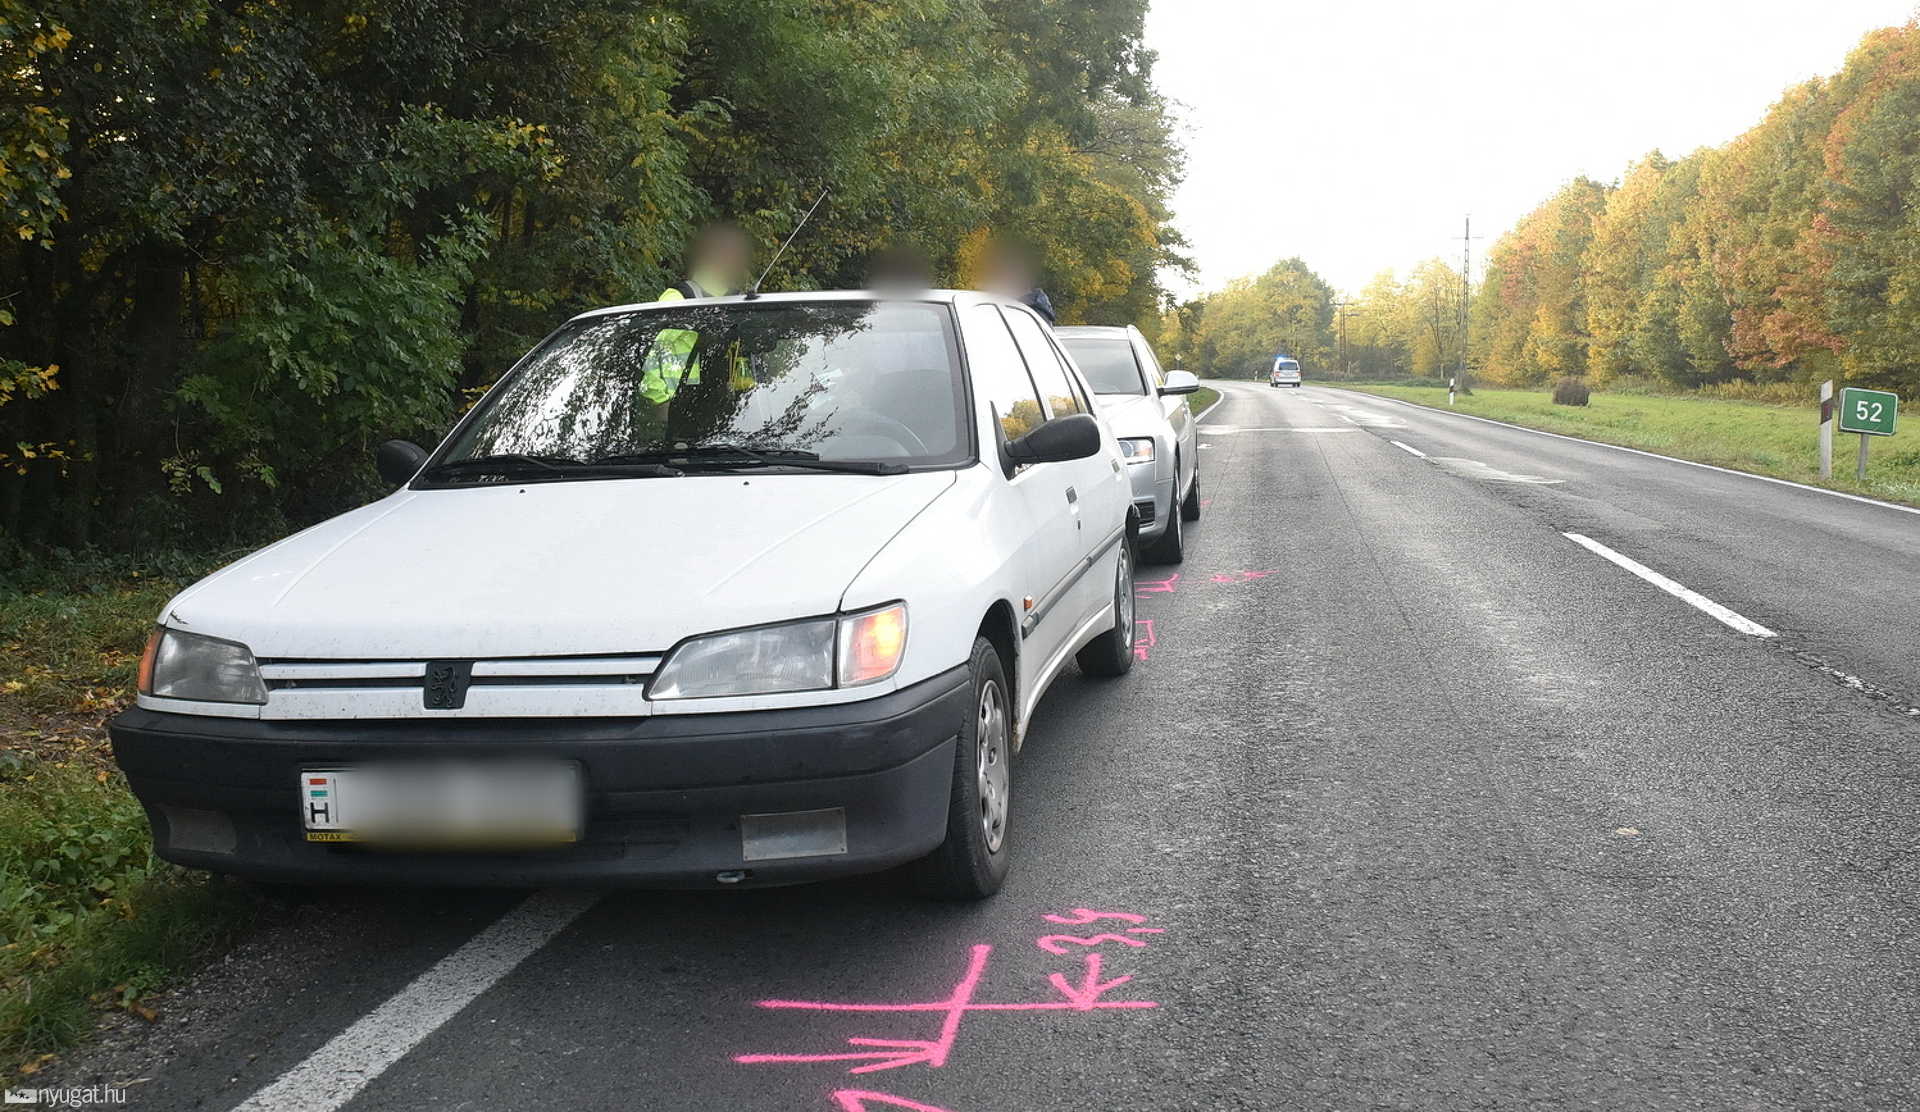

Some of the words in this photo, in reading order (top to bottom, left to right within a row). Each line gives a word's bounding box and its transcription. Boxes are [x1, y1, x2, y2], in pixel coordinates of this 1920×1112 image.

[1856, 402, 1882, 422] 52
[310, 802, 329, 823] H
[310, 832, 341, 841] MOTAX
